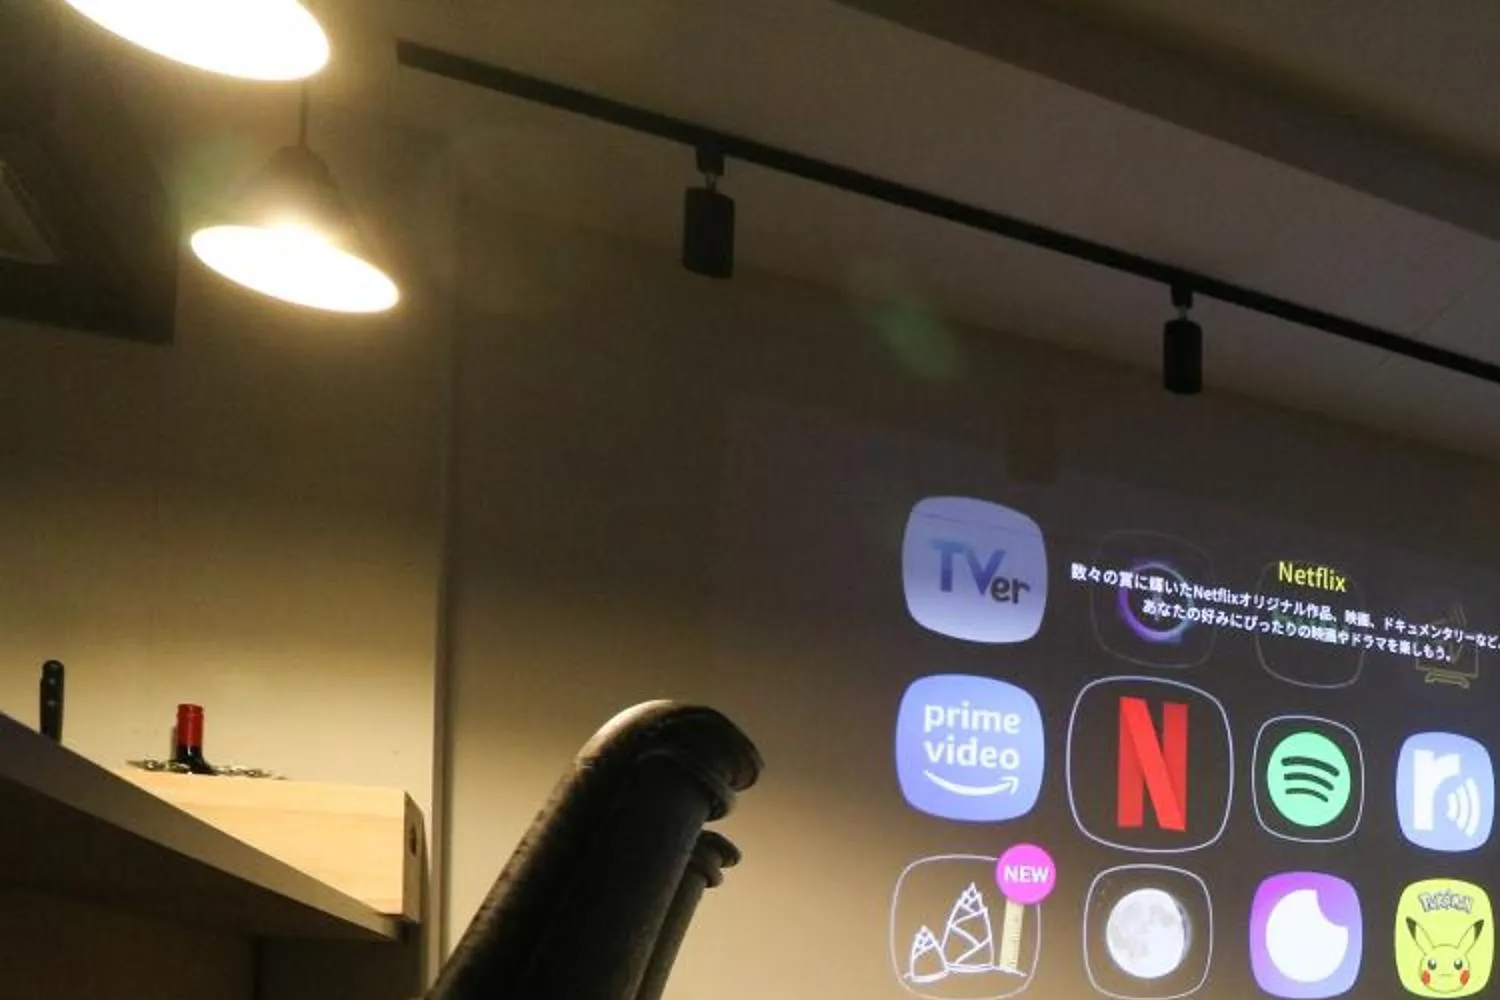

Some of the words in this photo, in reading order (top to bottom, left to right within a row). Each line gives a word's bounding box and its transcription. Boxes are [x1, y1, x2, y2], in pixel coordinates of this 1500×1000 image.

[930, 538, 1030, 604] TVer
[1278, 560, 1347, 592] Netflix
[924, 701, 1021, 734] prime
[924, 735, 1021, 770] video
[1118, 696, 1188, 832] N
[1003, 862, 1049, 884] NEW
